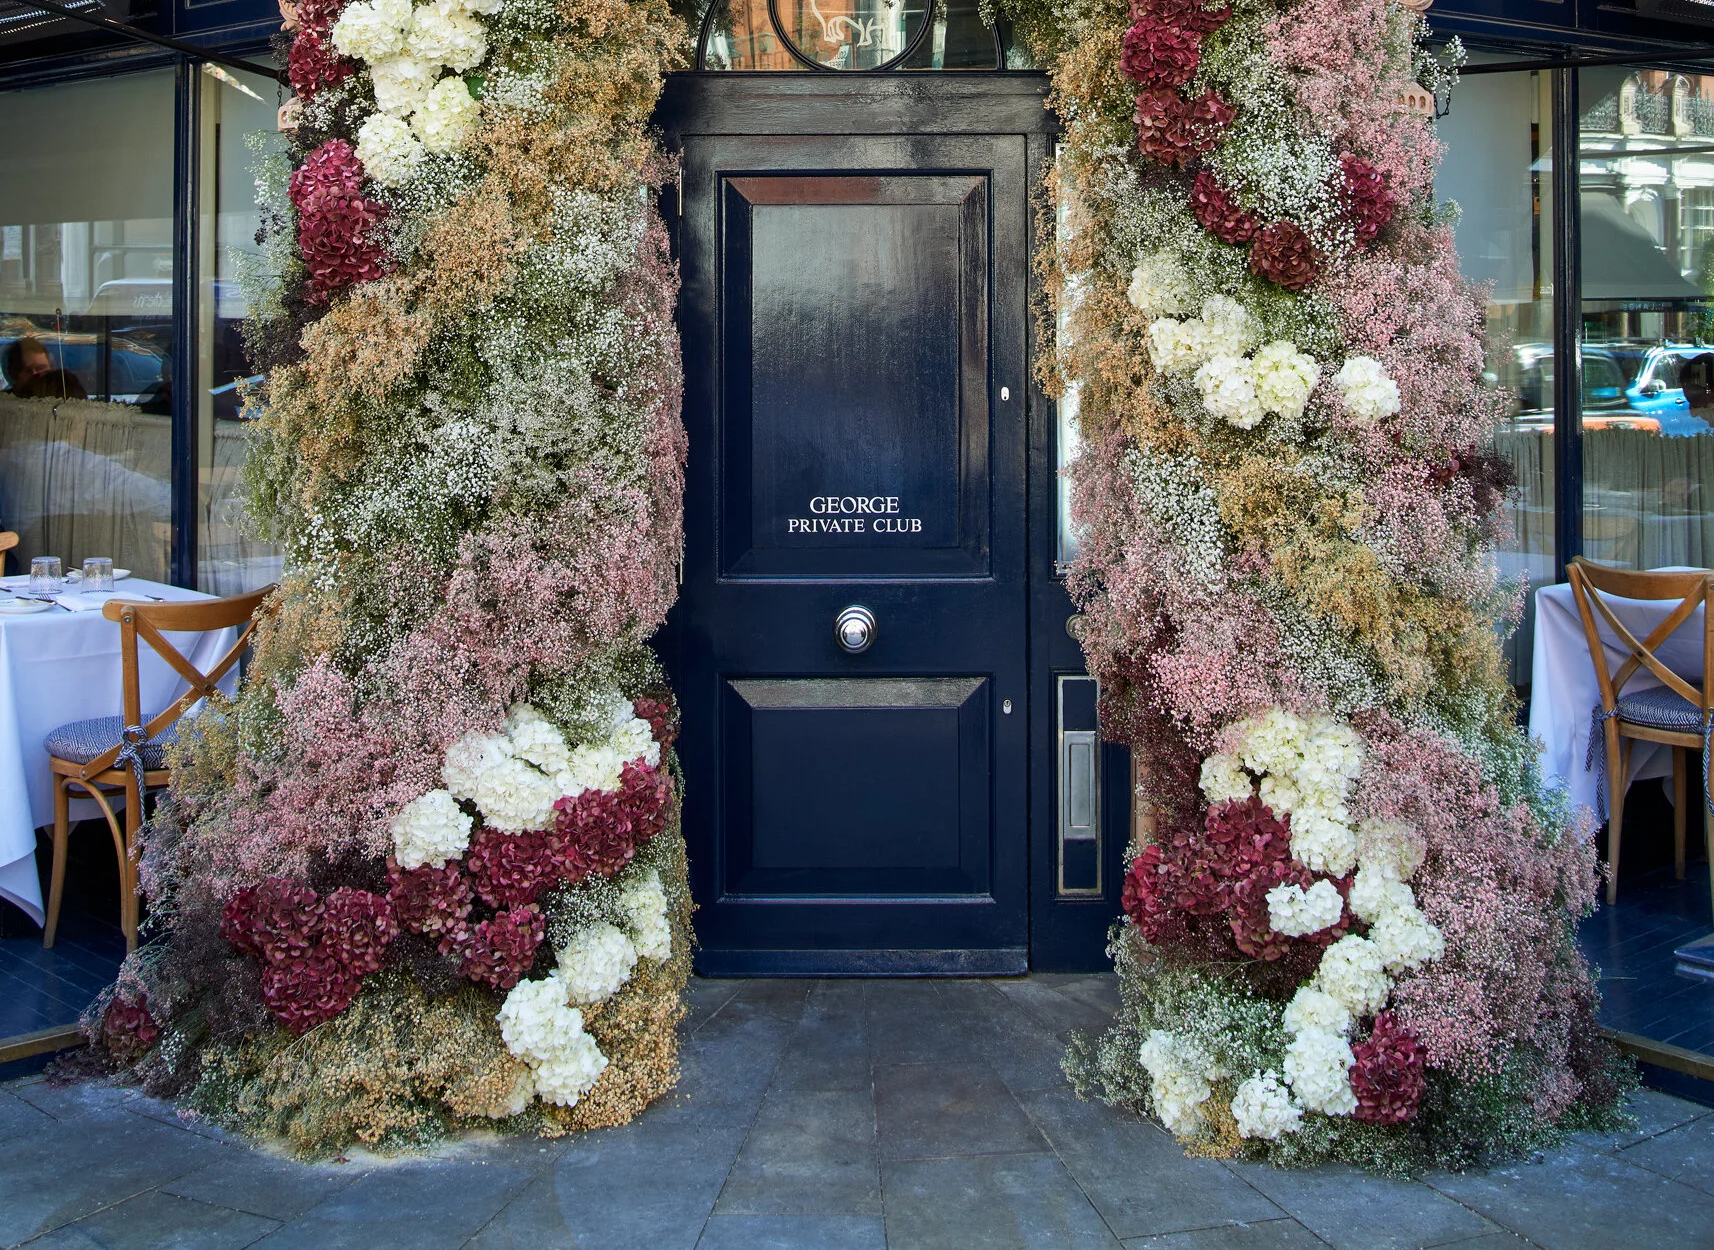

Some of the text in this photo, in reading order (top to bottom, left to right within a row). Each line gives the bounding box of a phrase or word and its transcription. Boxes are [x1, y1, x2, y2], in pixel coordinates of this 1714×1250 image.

[809, 496, 900, 514] GEORGE
[787, 518, 922, 533] PRIVATE CLUB
